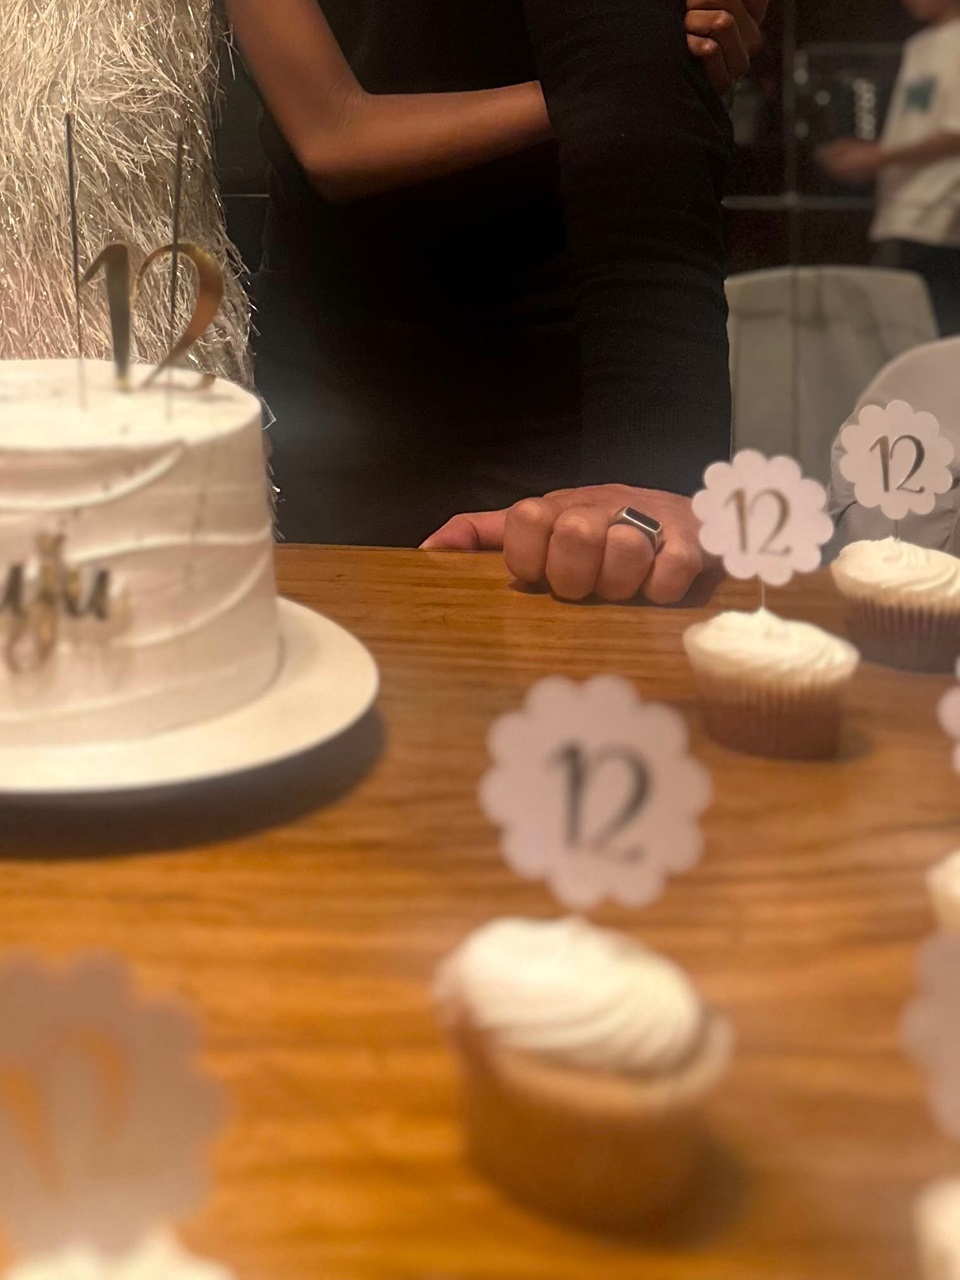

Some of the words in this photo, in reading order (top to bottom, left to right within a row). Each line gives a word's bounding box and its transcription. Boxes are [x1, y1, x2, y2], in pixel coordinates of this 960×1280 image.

[77, 241, 224, 392] 12
[868, 433, 926, 495] 12
[723, 486, 793, 558] 12
[548, 740, 652, 862] 12
